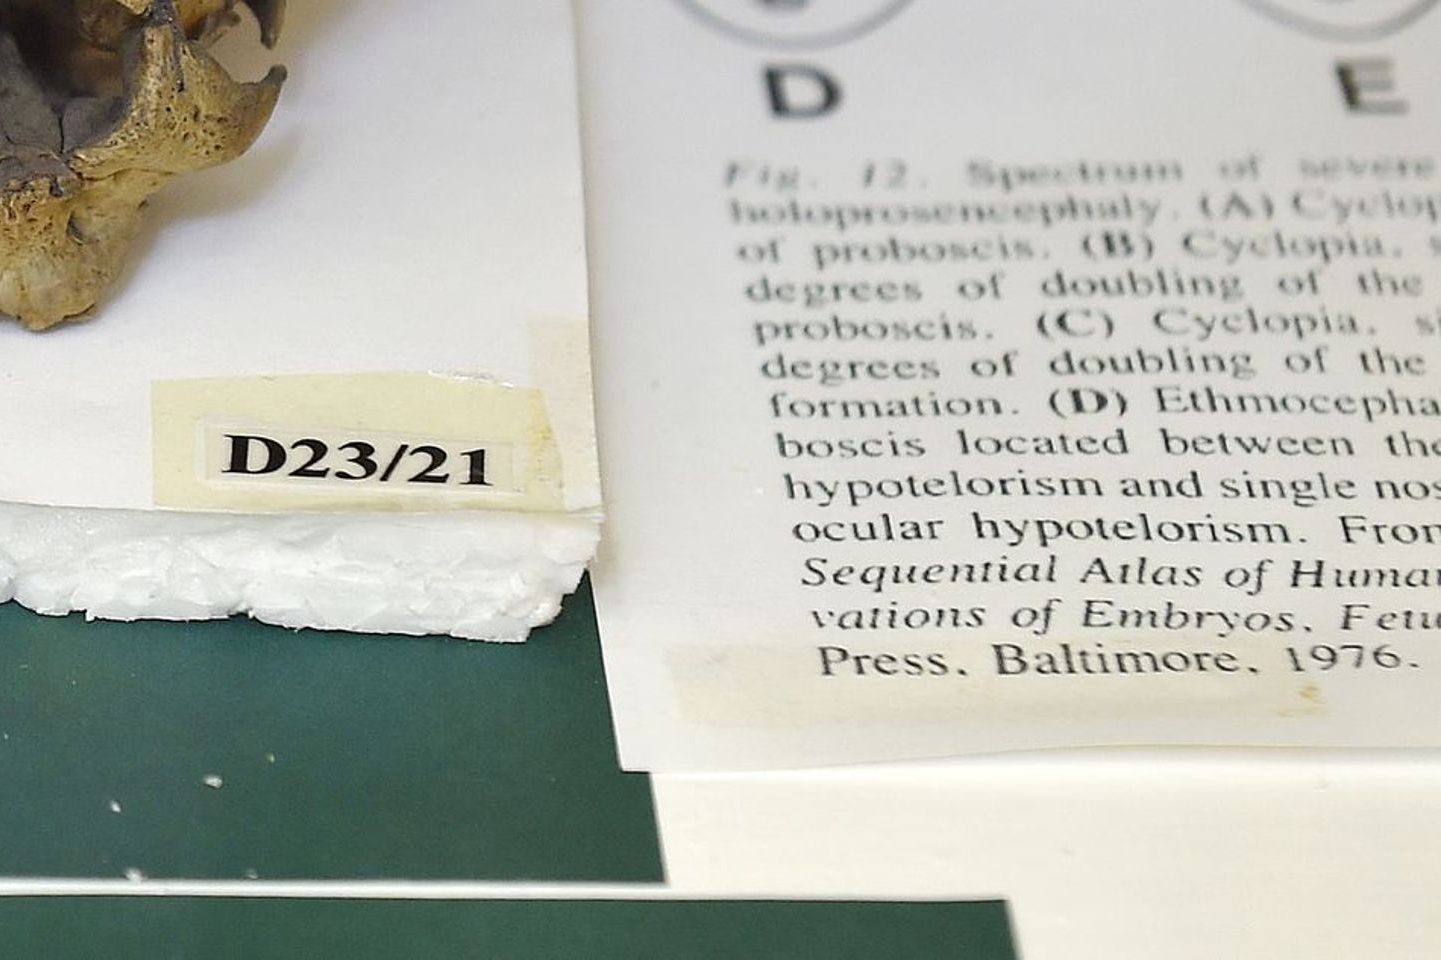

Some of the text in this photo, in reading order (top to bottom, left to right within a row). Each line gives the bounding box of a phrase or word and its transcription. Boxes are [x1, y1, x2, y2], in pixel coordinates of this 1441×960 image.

[762, 63, 844, 121] D
[1335, 61, 1411, 117] E
[968, 158, 1183, 193] Spectrum
[1218, 154, 1259, 180] of
[1200, 190, 1275, 220] (A)
[737, 237, 786, 263] of
[814, 236, 1052, 271] proboscis.
[1080, 230, 1155, 262] (B)
[745, 266, 1423, 308] degrees of doubling of the
[754, 312, 993, 346] proboscis.
[1036, 307, 1115, 340] (C)
[760, 344, 1426, 387] degrees of doubling of the
[770, 391, 1020, 419] formation.
[1049, 386, 1128, 419] (D)
[221, 433, 494, 487] D23/21
[775, 430, 927, 459] boscis
[957, 427, 1130, 456] located
[1160, 427, 1356, 457] between
[783, 468, 1104, 507] hypotelorism
[1120, 469, 1204, 499] and
[1220, 469, 1358, 507] single
[792, 512, 945, 543] ocular
[972, 511, 1308, 548] hypotelorism.
[801, 554, 1441, 596] Sequential Atlas of Huma
[812, 601, 987, 630] vations
[1011, 598, 1063, 635] of
[1286, 642, 1421, 673] 1976.
